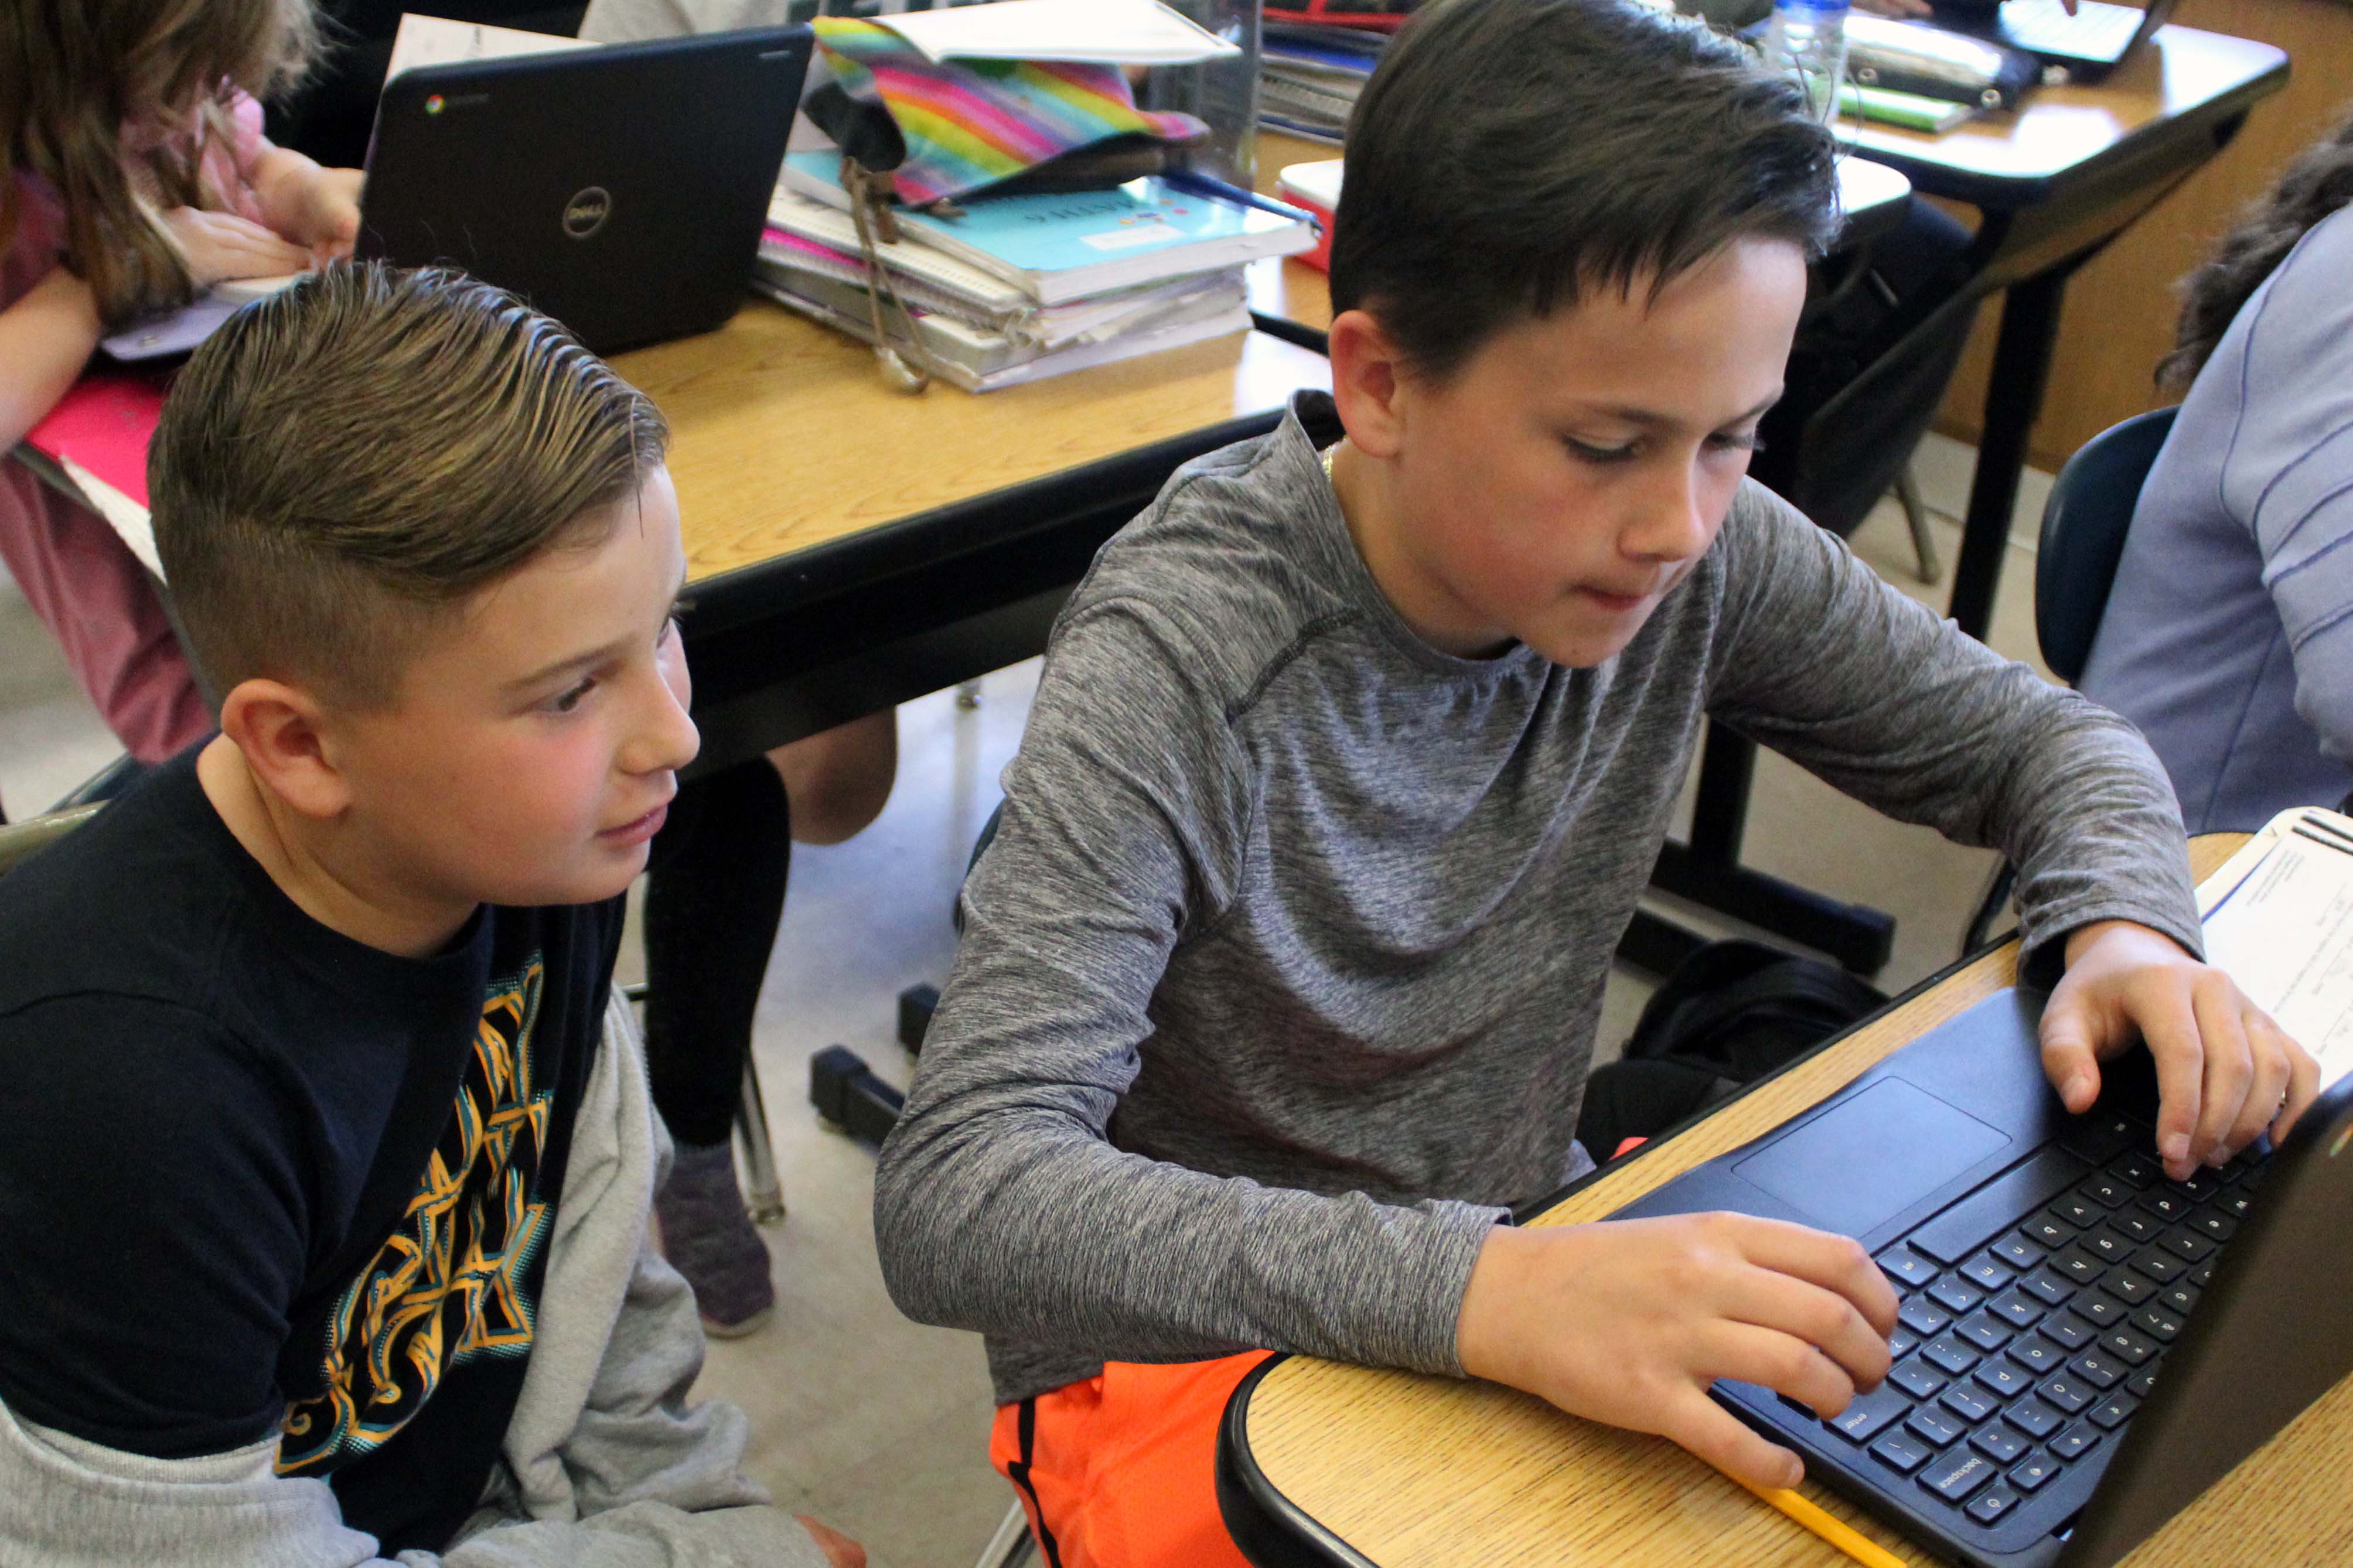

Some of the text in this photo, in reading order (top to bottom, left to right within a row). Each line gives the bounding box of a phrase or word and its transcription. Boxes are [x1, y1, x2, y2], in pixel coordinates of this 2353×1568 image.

[2159, 1201, 2170, 1210] d
[2132, 1221, 2143, 1229] f
[2044, 1226, 2057, 1234] b
[2099, 1239, 2112, 1249] g
[2013, 1246, 2024, 1255] n
[2072, 1261, 2086, 1269] h
[1980, 1266, 1994, 1276] m
[2041, 1281, 2055, 1292] j
[2123, 1280, 2135, 1290] y
[2175, 1292, 2187, 1301] 6
[2011, 1304, 2025, 1313] k
[2093, 1304, 2105, 1313] u
[2149, 1314, 2160, 1323] 7
[2064, 1327, 2076, 1335] i
[2116, 1337, 2129, 1345] 8
[2031, 1350, 2042, 1358] o
[2085, 1360, 2098, 1369] 9
[1999, 1371, 2011, 1381] p
[1845, 1413, 1867, 1429] enter
[1937, 1458, 1982, 1489] backspace
